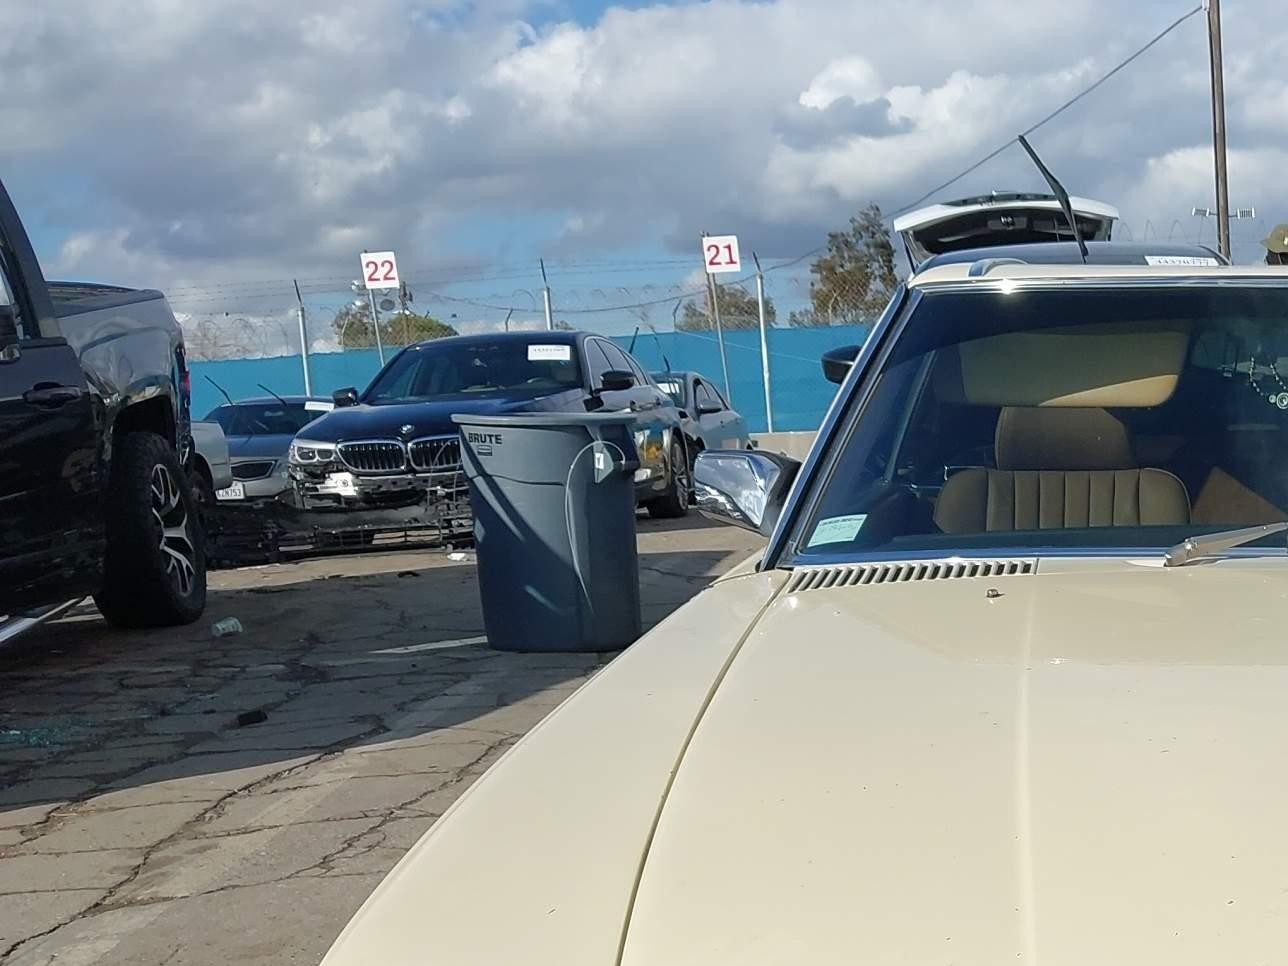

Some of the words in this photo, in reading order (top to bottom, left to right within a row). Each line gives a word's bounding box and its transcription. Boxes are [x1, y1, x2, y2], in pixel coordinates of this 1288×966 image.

[707, 244, 737, 266] 21
[365, 260, 396, 281] 22
[468, 432, 503, 445] BRUTE
